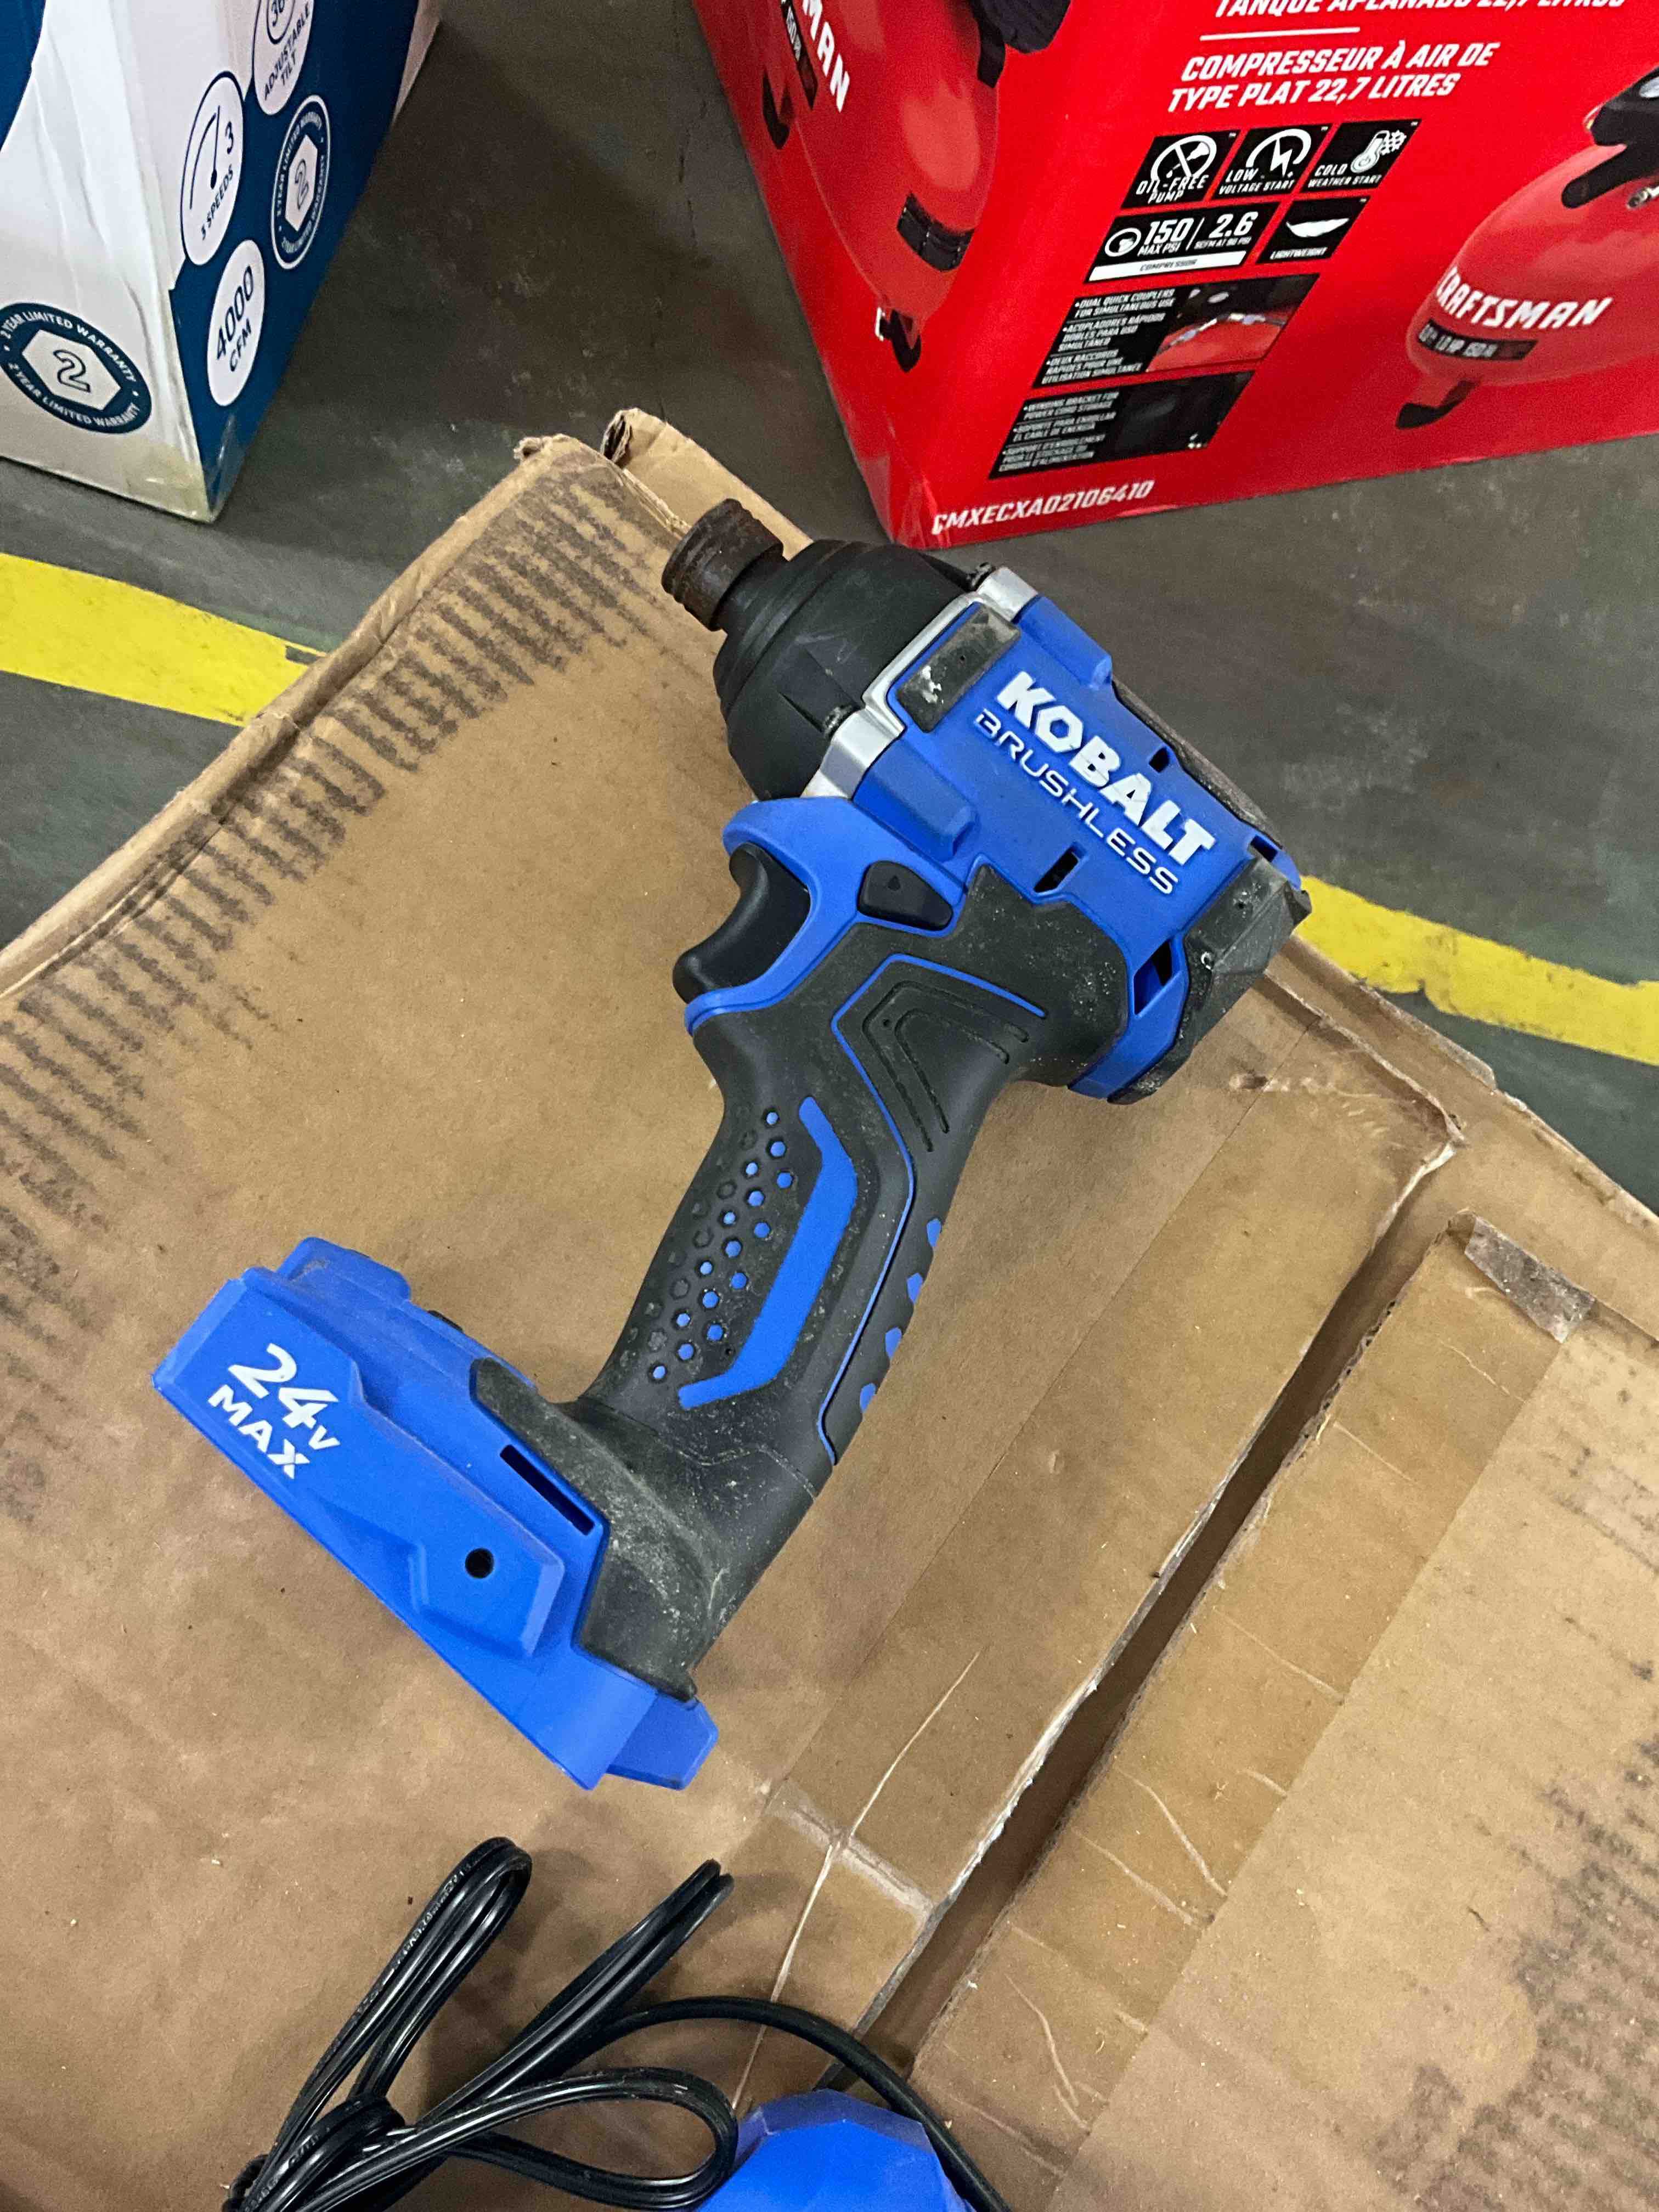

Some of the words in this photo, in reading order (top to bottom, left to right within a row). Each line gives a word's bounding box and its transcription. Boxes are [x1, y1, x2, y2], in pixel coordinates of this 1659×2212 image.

[264, 2, 309, 101] ADJUSTABLE
[281, 48, 297, 86] TILT
[1182, 46, 1378, 82] COMPRESSEUR
[1381, 40, 1406, 69] À
[1410, 44, 1457, 69] AIR
[1457, 42, 1501, 67] DE
[1167, 84, 1235, 112] TYPE
[1238, 80, 1309, 108] PLAT
[1307, 76, 1372, 105] 22,7
[1369, 72, 1462, 99] LITRES
[225, 121, 234, 154] 3
[294, 159, 309, 211] 2
[1218, 182, 1261, 195] VOLTAGE
[1262, 179, 1295, 192] START
[1225, 168, 1260, 183] LOW
[1307, 176, 1352, 189] WEATHER
[1351, 174, 1383, 185] START
[1314, 163, 1348, 177] COLD
[201, 224, 206, 240] 3
[207, 163, 233, 229] SPEEDS
[1147, 190, 1184, 205] PUMP
[1145, 217, 1194, 244] 150
[1208, 211, 1259, 239] 2.6
[1137, 241, 1163, 257] MAX
[1163, 240, 1182, 254] PSI
[1139, 258, 1198, 272] COMPRESSOR
[1270, 246, 1328, 261] LIGHTWEIGHT
[217, 266, 253, 360] 4000
[1436, 266, 1614, 329] CRAFTSMAN
[22, 311, 73, 329] LIMITED
[77, 324, 137, 382] WARRANTY
[229, 318, 252, 372] CFM
[53, 349, 91, 393] 2
[42, 396, 93, 425] LIMITED
[92, 402, 140, 427] WARRANTY
[996, 670, 1216, 866] KOBALT
[973, 708, 1178, 895] BRUSHLESS
[207, 1384, 311, 1480] MAX
